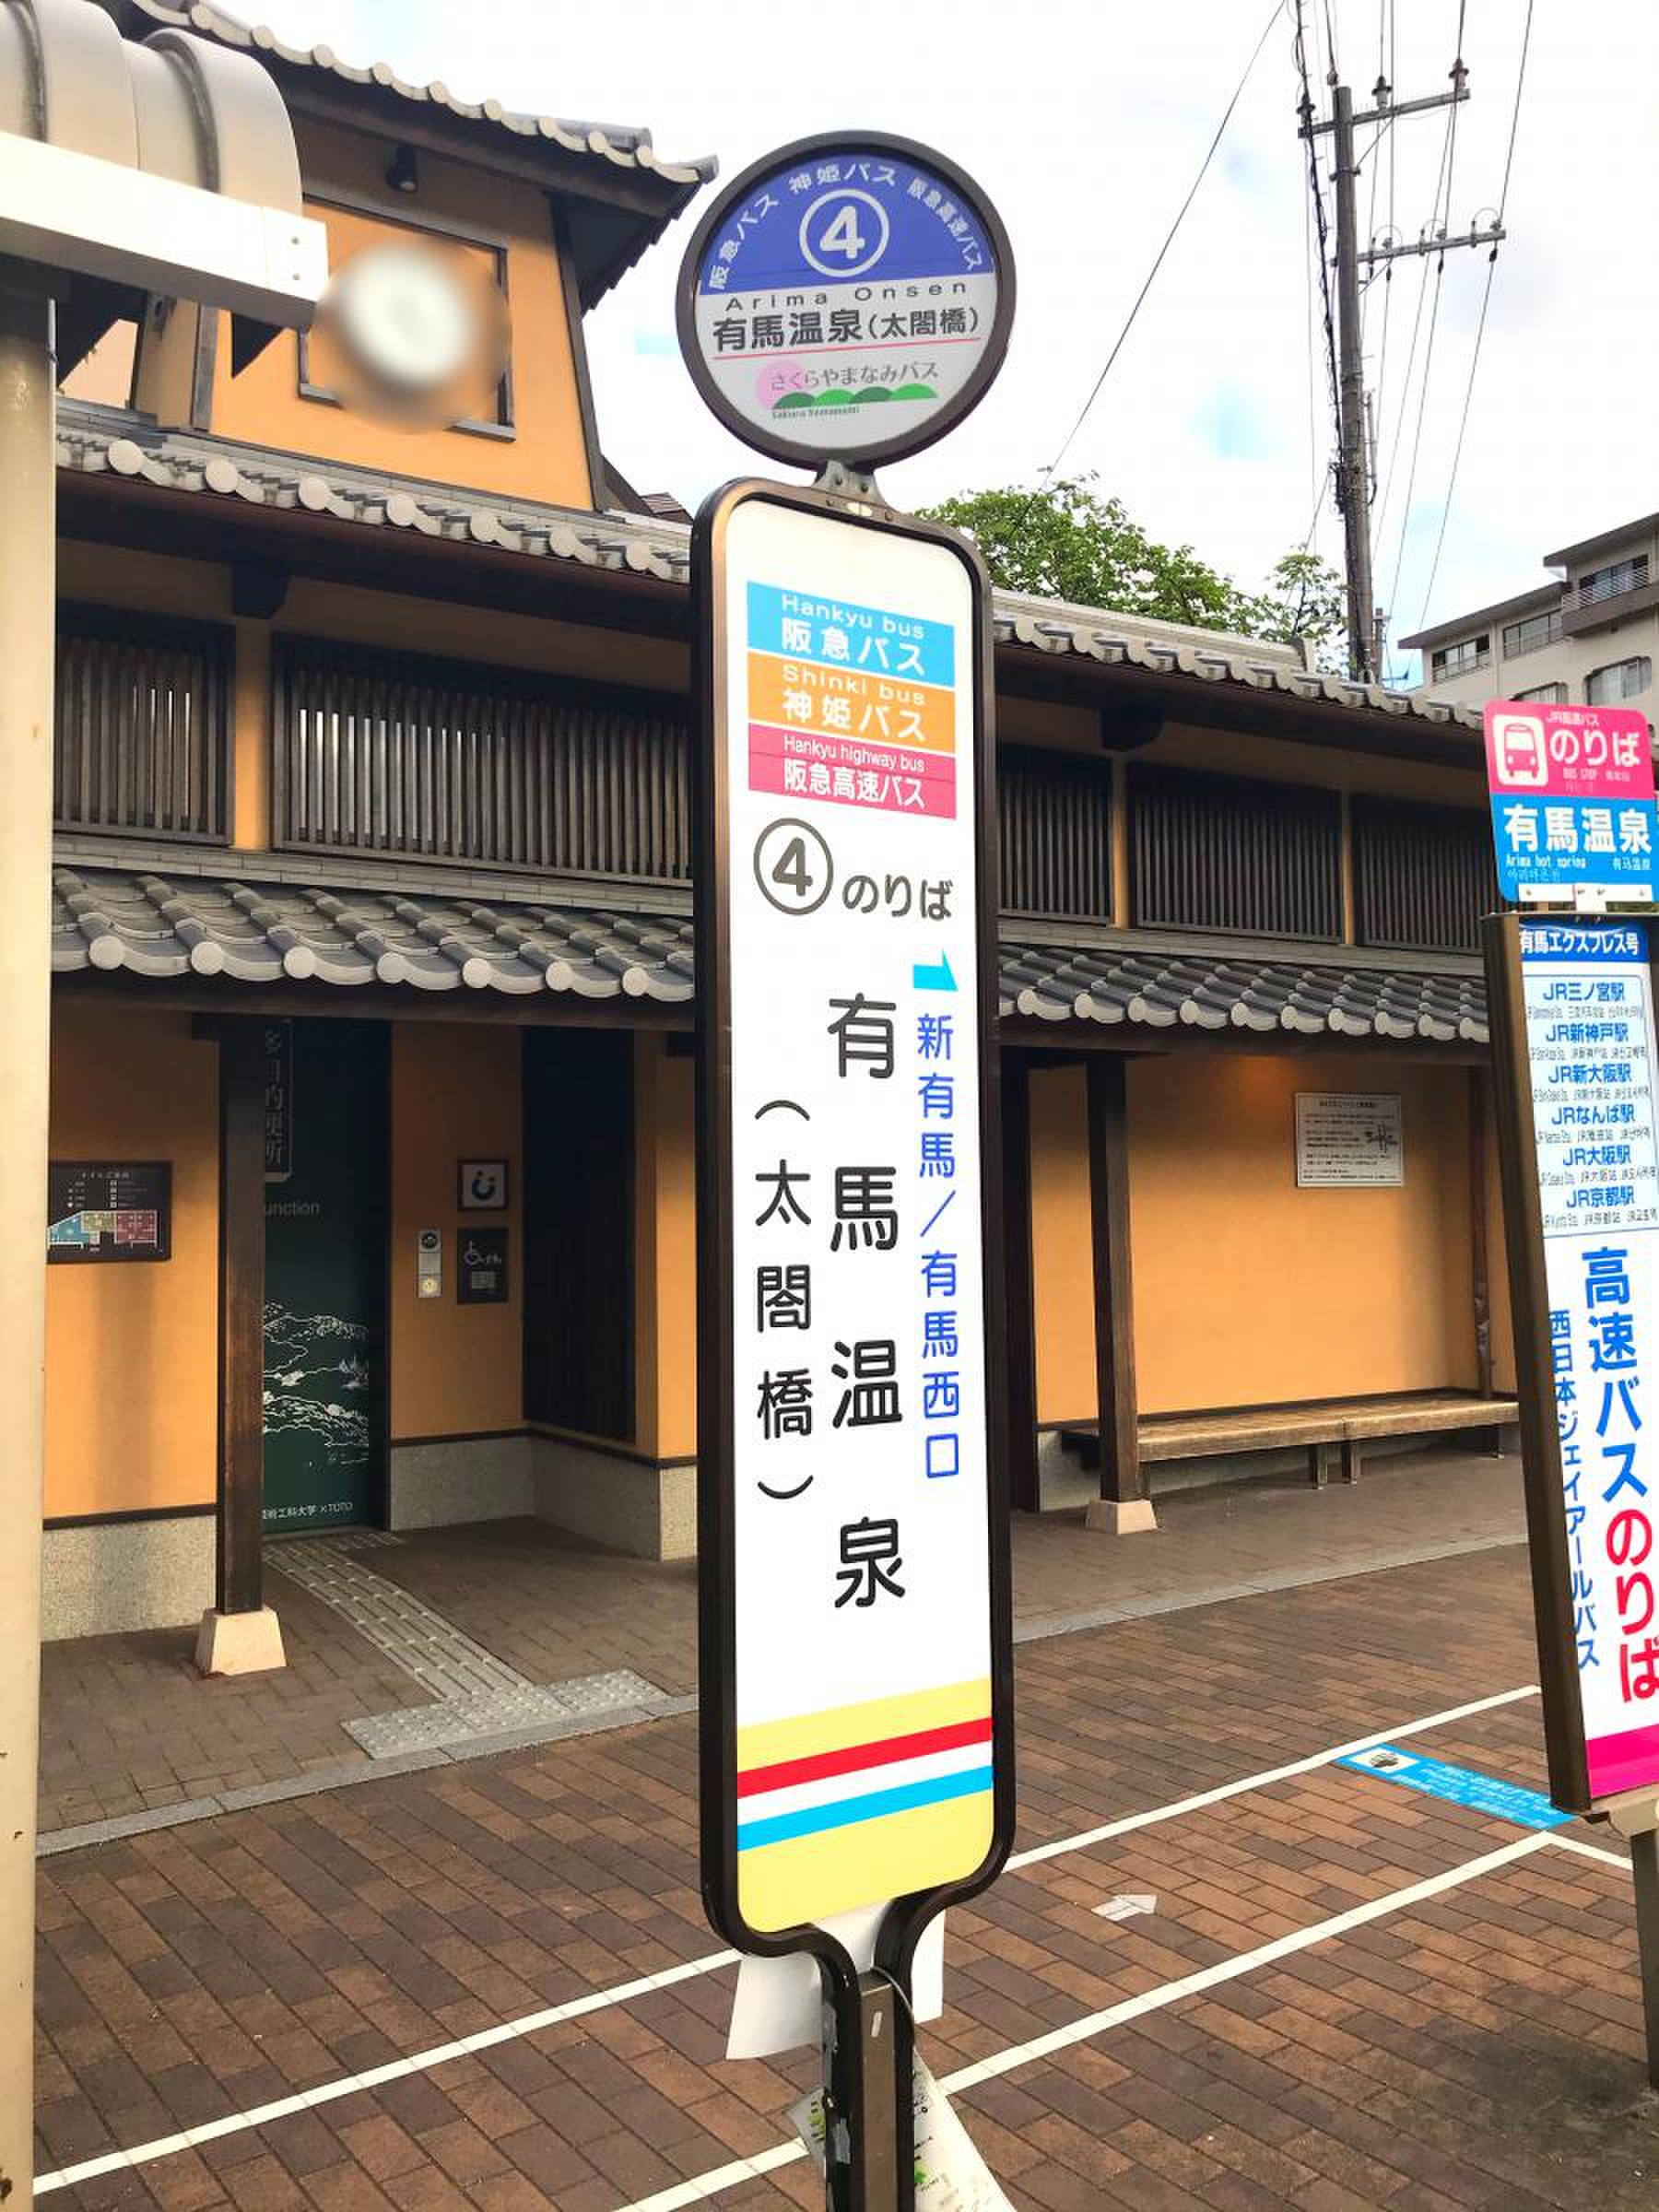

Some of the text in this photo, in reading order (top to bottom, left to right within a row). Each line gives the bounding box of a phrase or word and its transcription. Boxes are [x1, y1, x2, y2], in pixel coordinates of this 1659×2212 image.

[789, 163, 896, 194] 神姫バス
[709, 193, 780, 289] 阪急バス
[908, 179, 982, 269] 阪急高速バス
[725, 282, 967, 312] Arima Onsen
[771, 361, 939, 391] さくらやまなみバス
[782, 594, 924, 639] Hankyu bus
[782, 618, 925, 676] 阪急バス
[782, 665, 925, 705] Shinki bus
[782, 689, 925, 742] 神姫バス
[783, 735, 925, 773] Hankyu highway bus
[1550, 729, 1641, 767] のりば
[783, 759, 925, 808] 阪急高速バス
[1504, 804, 1652, 853] 有馬温泉
[1543, 982, 1625, 1002] JR三ノ宮駅
[1546, 1023, 1630, 1043] JR新神戸駅
[1548, 1063, 1633, 1084] JR新大阪駅
[1563, 1145, 1632, 1166] JR大阪駅
[1566, 1186, 1635, 1208] JR京都駅
[828, 992, 906, 1609] 有馬温泉
